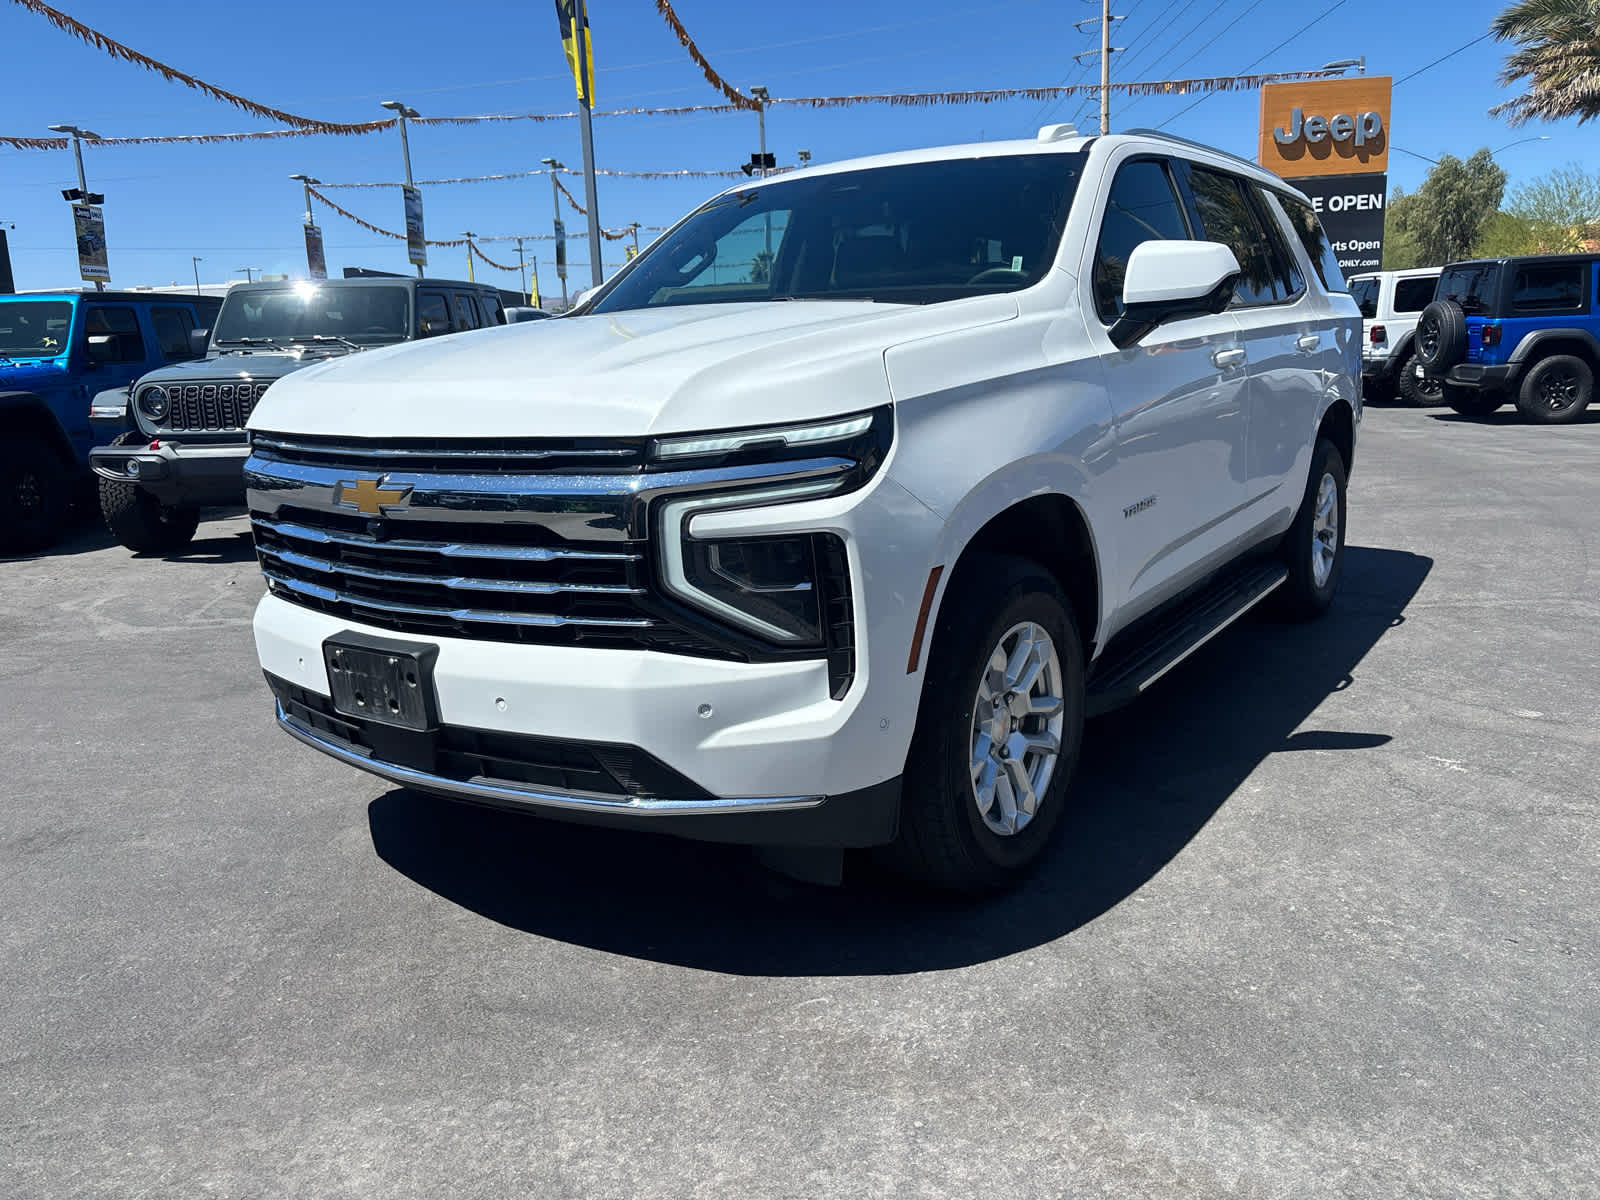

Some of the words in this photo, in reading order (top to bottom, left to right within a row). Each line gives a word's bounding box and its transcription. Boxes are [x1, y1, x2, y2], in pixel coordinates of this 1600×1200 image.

[1273, 107, 1383, 147] Jeep
[1328, 193, 1383, 212] OPEN
[1348, 240, 1381, 253] Open
